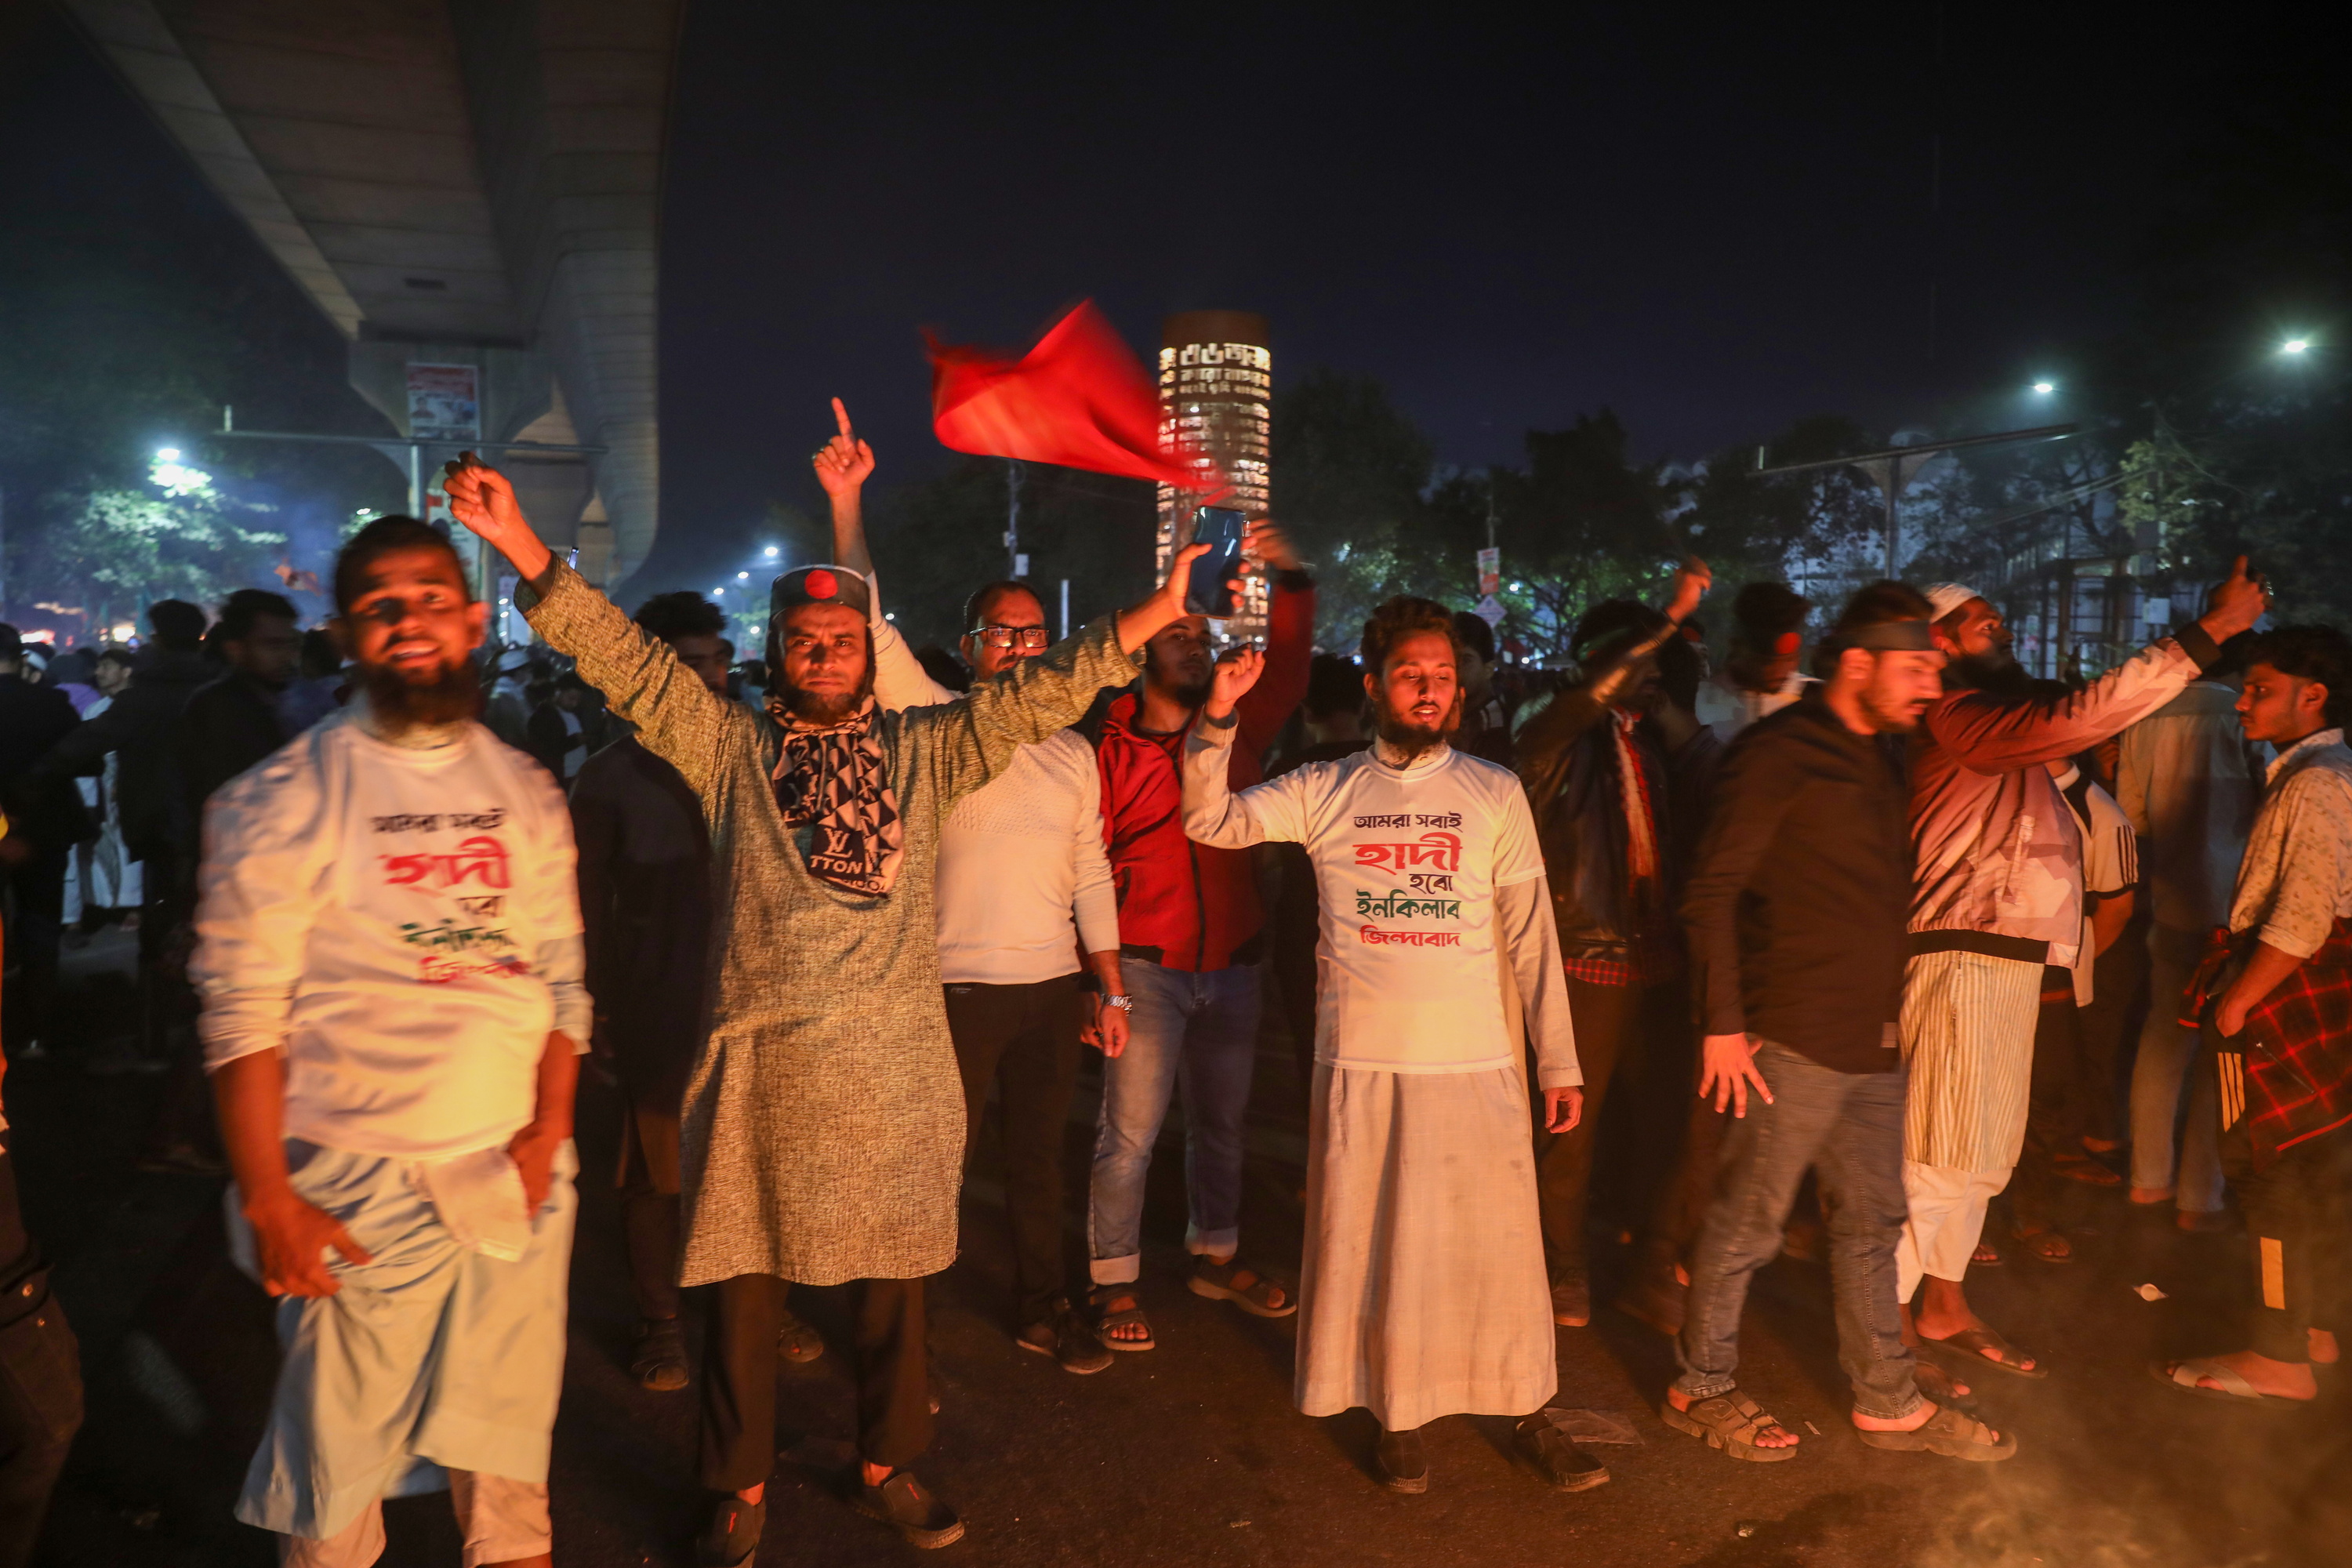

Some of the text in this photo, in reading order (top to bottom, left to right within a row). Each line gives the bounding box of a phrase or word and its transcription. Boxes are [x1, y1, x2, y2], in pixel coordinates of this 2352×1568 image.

[1354, 811, 1463, 833] আমরা সবাই
[1352, 831, 1463, 875] হাদী
[1409, 873, 1453, 895] হবো
[1356, 888, 1462, 922] ইনকিলাব
[1359, 924, 1461, 947] জিন্দাবাদ
